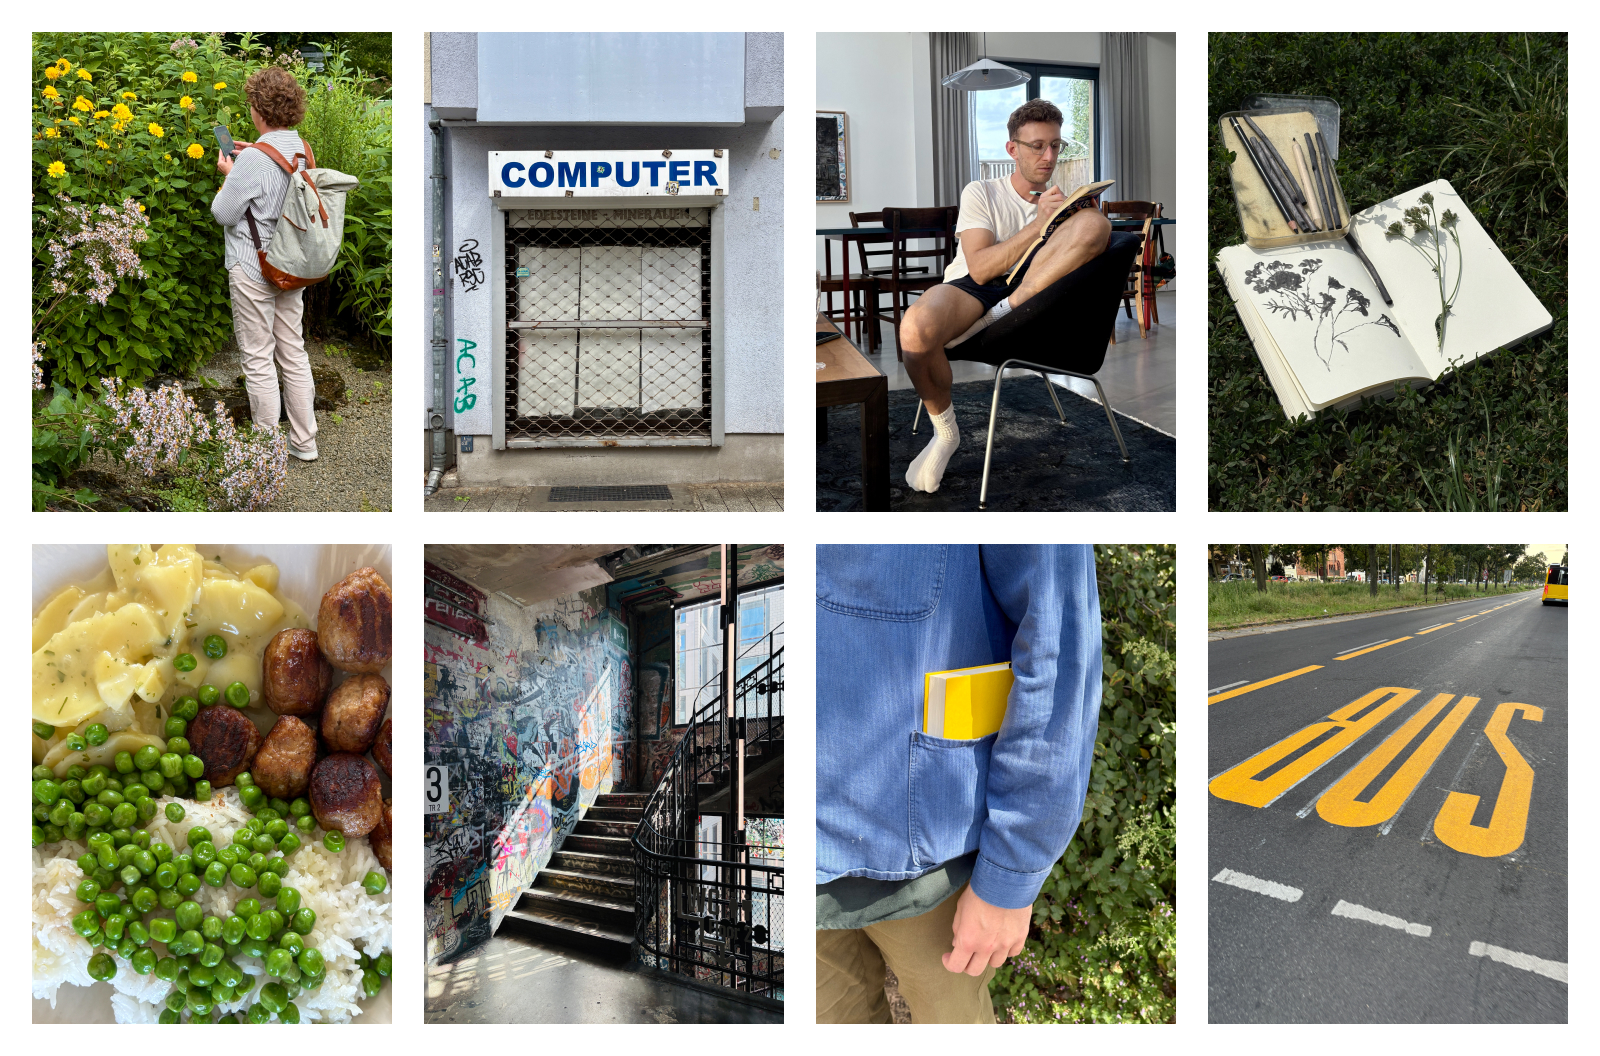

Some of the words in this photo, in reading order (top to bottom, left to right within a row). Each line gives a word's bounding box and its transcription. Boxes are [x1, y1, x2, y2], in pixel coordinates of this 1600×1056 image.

[501, 160, 718, 188] COMPUTER
[527, 209, 598, 220] EDELSTEINE
[426, 766, 442, 802] 3
[1208, 686, 1544, 858] BUS
[429, 804, 436, 812] TR
[687, 884, 719, 915] WC
[708, 919, 740, 941] Floor
[743, 925, 752, 943] 2
